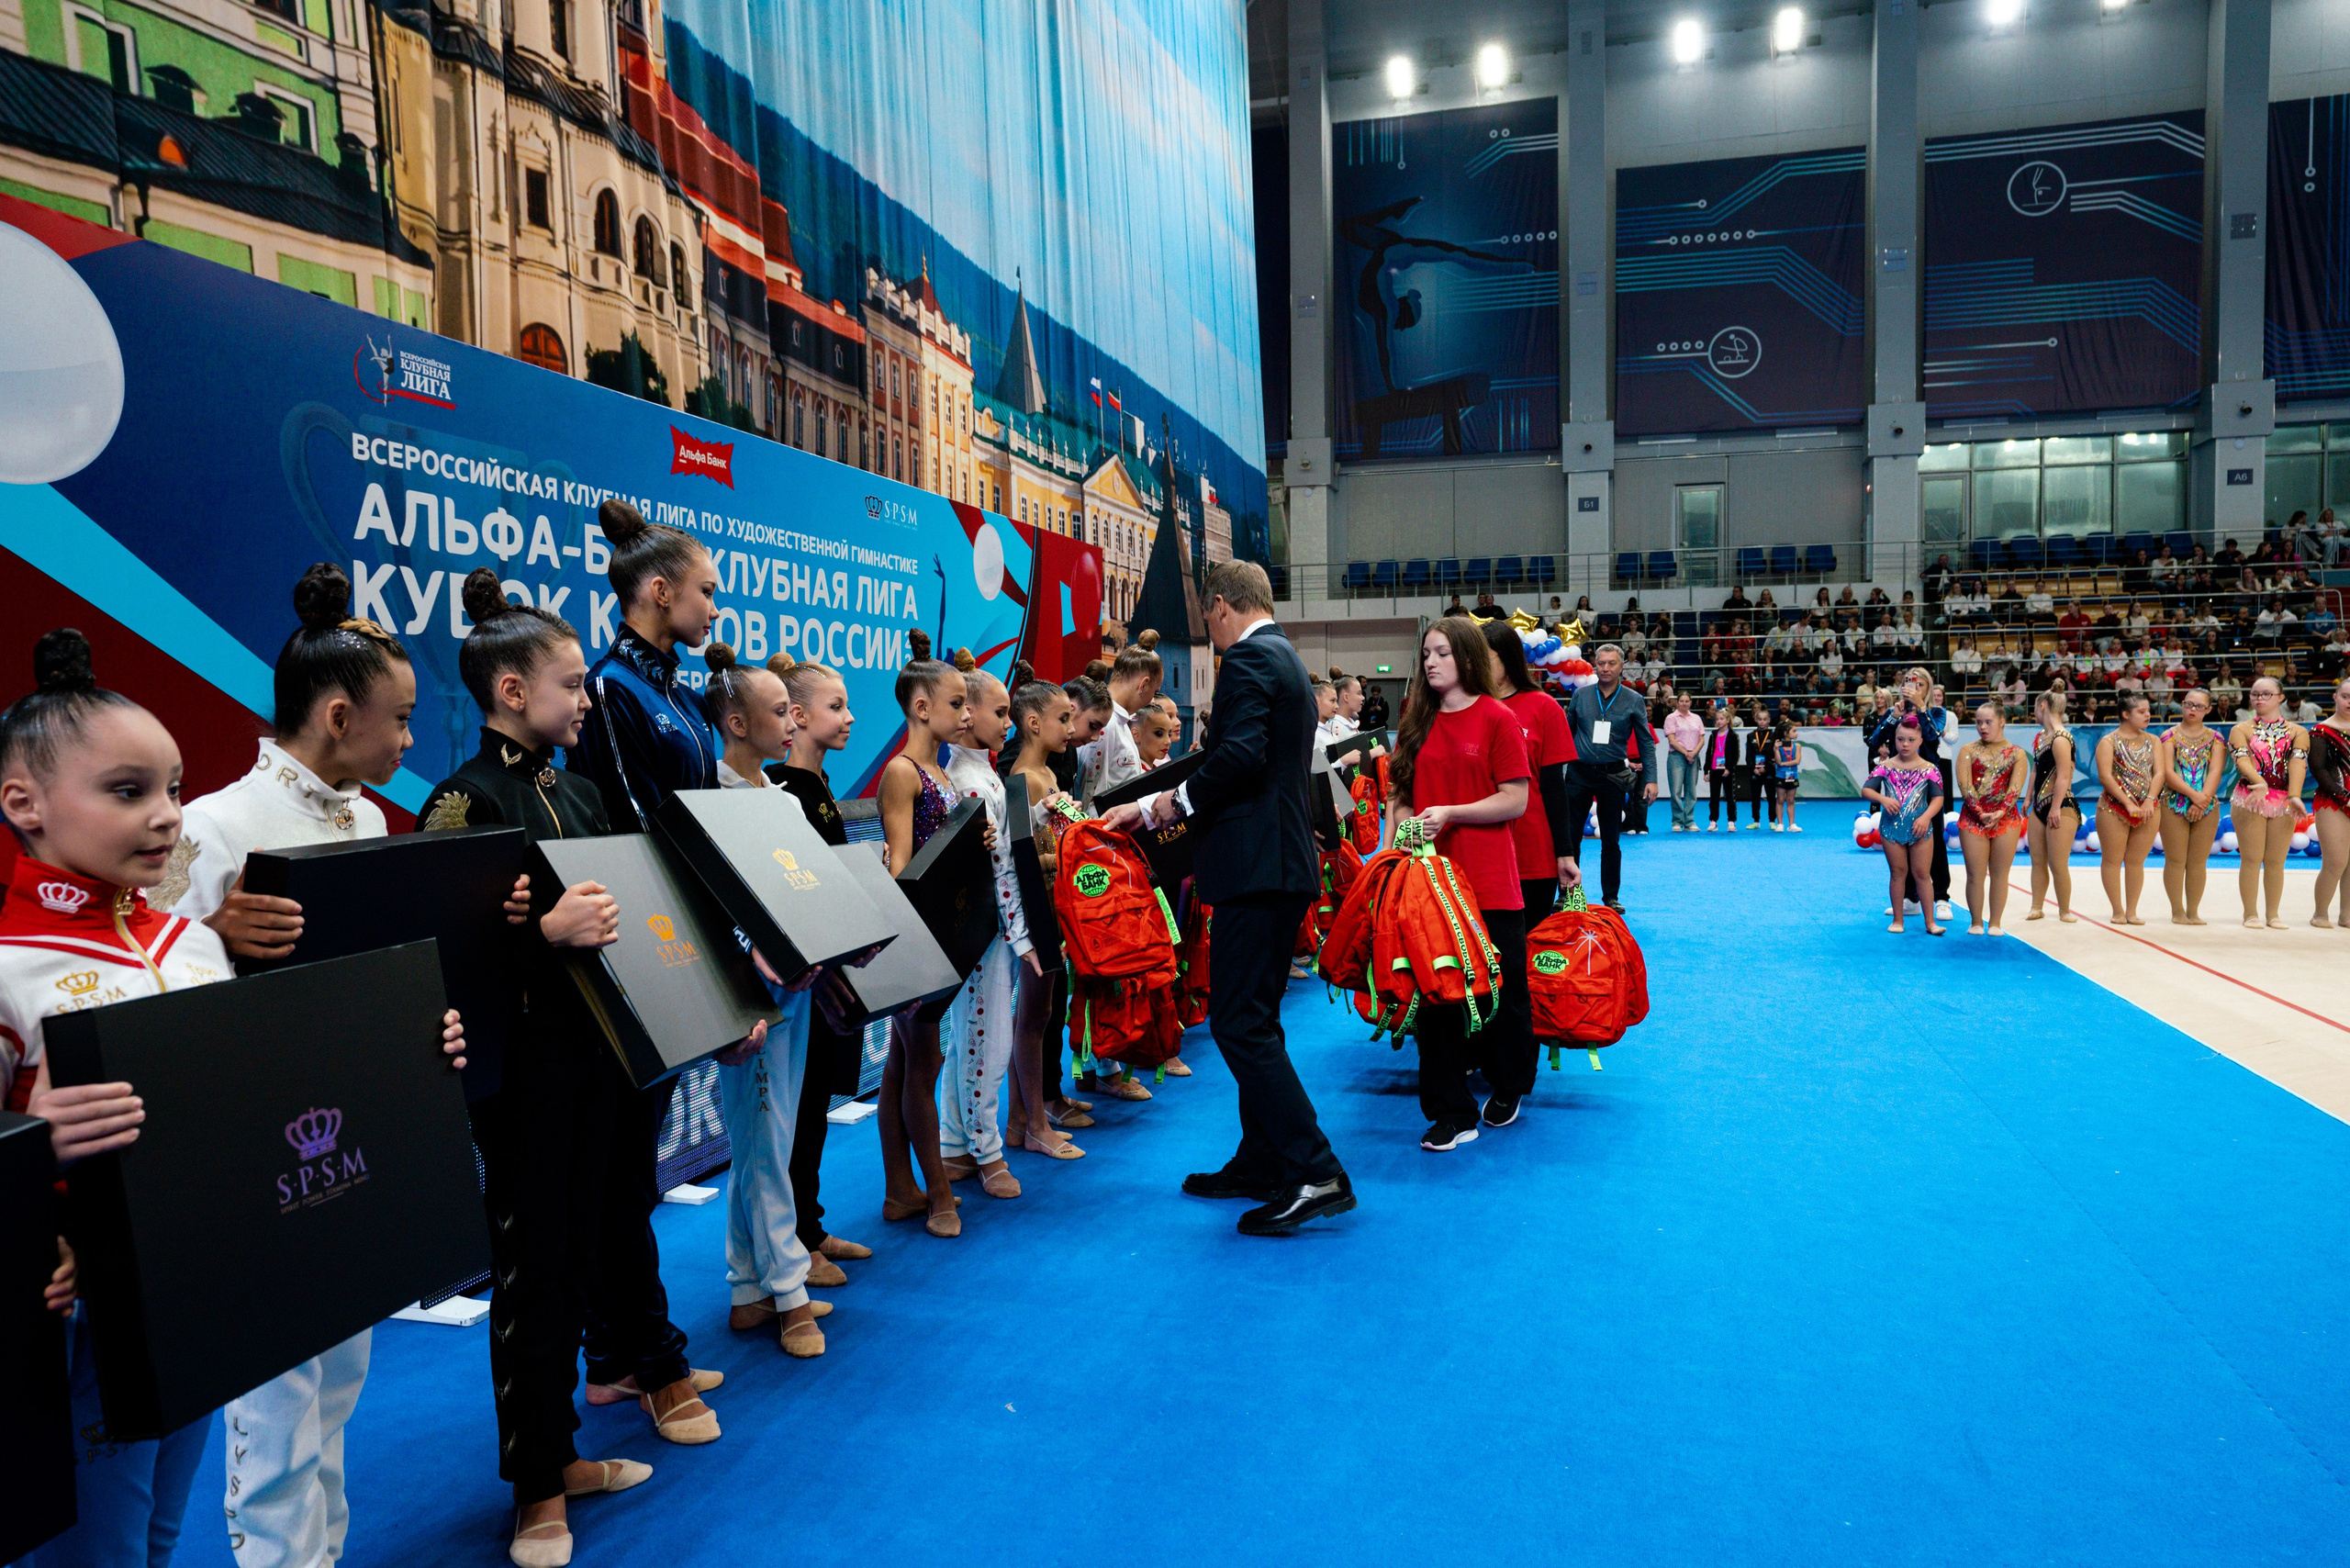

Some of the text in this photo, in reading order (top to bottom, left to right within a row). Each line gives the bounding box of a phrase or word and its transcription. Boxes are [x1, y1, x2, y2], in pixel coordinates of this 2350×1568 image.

[400, 351, 451, 371] ВСЕРОССИЙСКАЯ
[400, 358, 451, 382] КЛУБНАЯ
[401, 371, 452, 400] ЛИГА
[679, 445, 727, 469] Альфа Банк
[352, 432, 557, 500] ВСЕРОССИЙСКАЯ
[655, 501, 697, 530] ЛИГА
[701, 511, 722, 534] ПО
[727, 517, 848, 561] ХУДОЖЕСТВЕННОЙ
[851, 545, 918, 575] ГИМНАСТИКЕ
[353, 483, 918, 621] АЛЬФА-Б КЛУБНАЯ ЛИГА
[779, 614, 901, 671] РОССИИ
[1076, 868, 1108, 884] АЛЬФА
[1081, 877, 1106, 890] БАНК
[1426, 863, 1438, 883] ДЛЯ
[1435, 885, 1455, 921] УМНЫХ
[1443, 860, 1455, 881] ДЛЯ
[1451, 882, 1472, 918] УМНЫХ
[1535, 955, 1567, 965] АЛЬФА
[1537, 960, 1561, 969] БАНК
